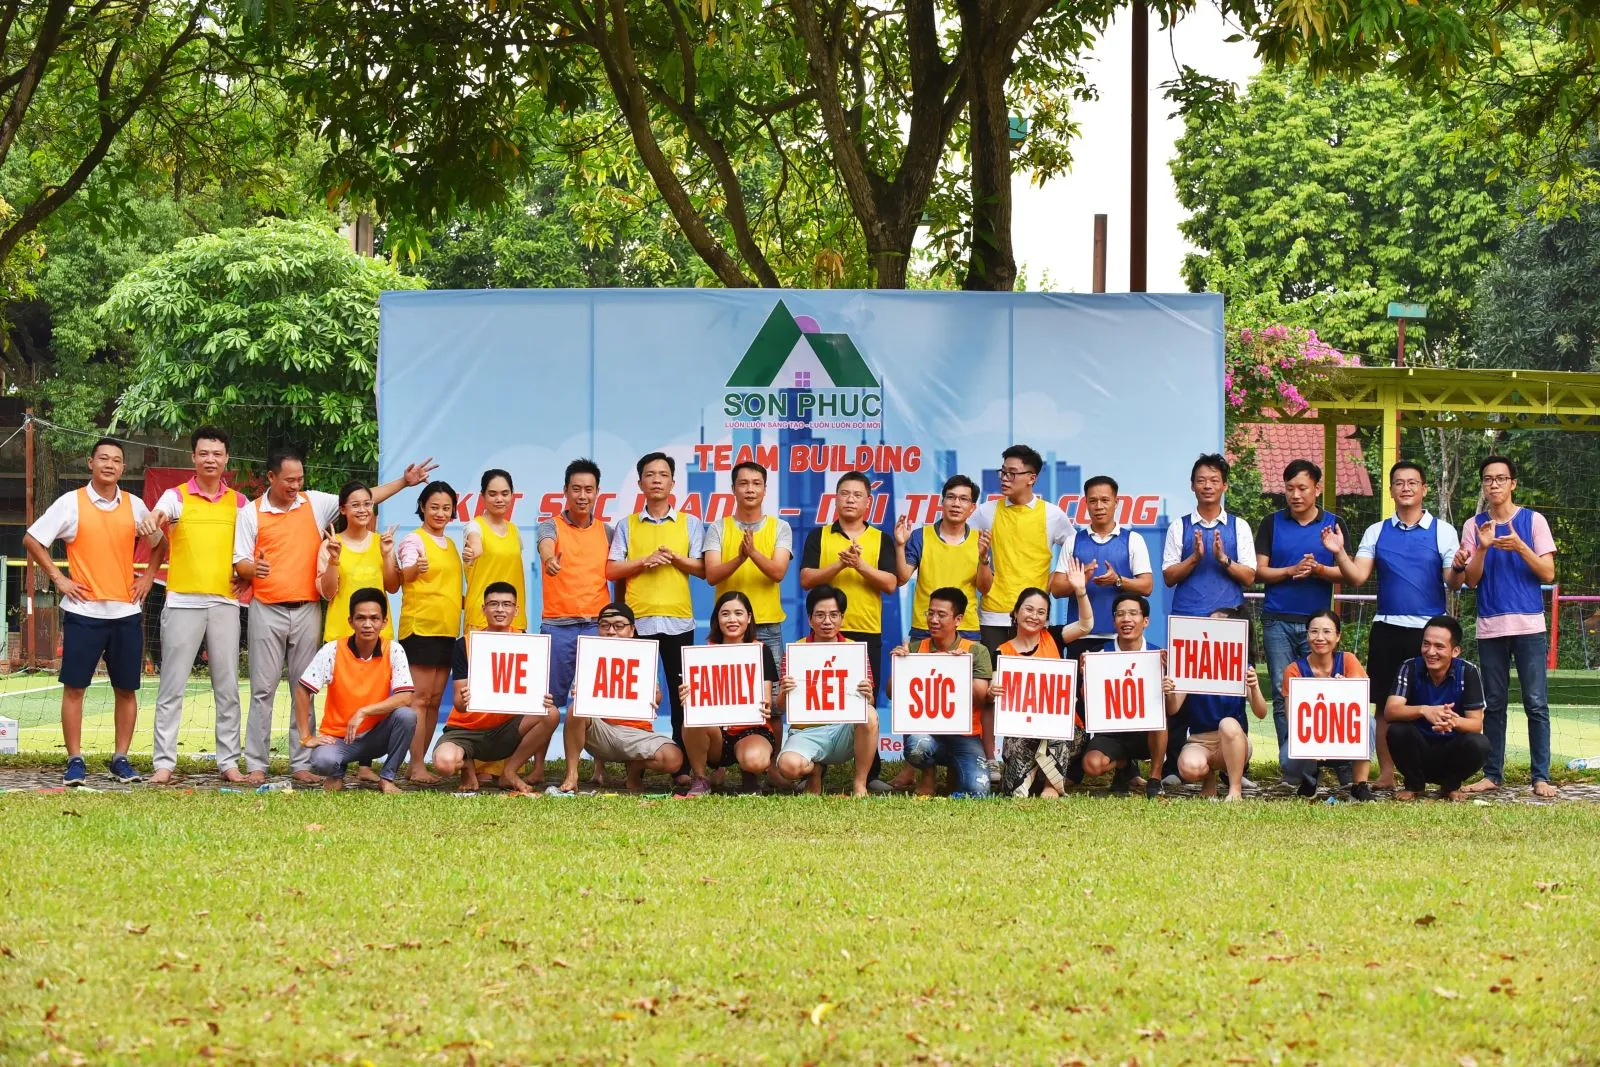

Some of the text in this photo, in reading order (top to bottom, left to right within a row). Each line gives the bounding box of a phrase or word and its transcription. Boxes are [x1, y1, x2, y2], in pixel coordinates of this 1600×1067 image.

[695, 444, 921, 472] TEAM BUILDING
[491, 652, 528, 694] WE
[592, 657, 640, 700] ARE
[1172, 631, 1243, 682] THÀNH
[689, 663, 756, 707] FAMILY
[805, 655, 848, 711] KẾT
[909, 668, 955, 719] SỨC
[1001, 671, 1072, 722] MẠNH
[1104, 663, 1145, 720] NỐI
[1297, 693, 1361, 744] CÔNG
